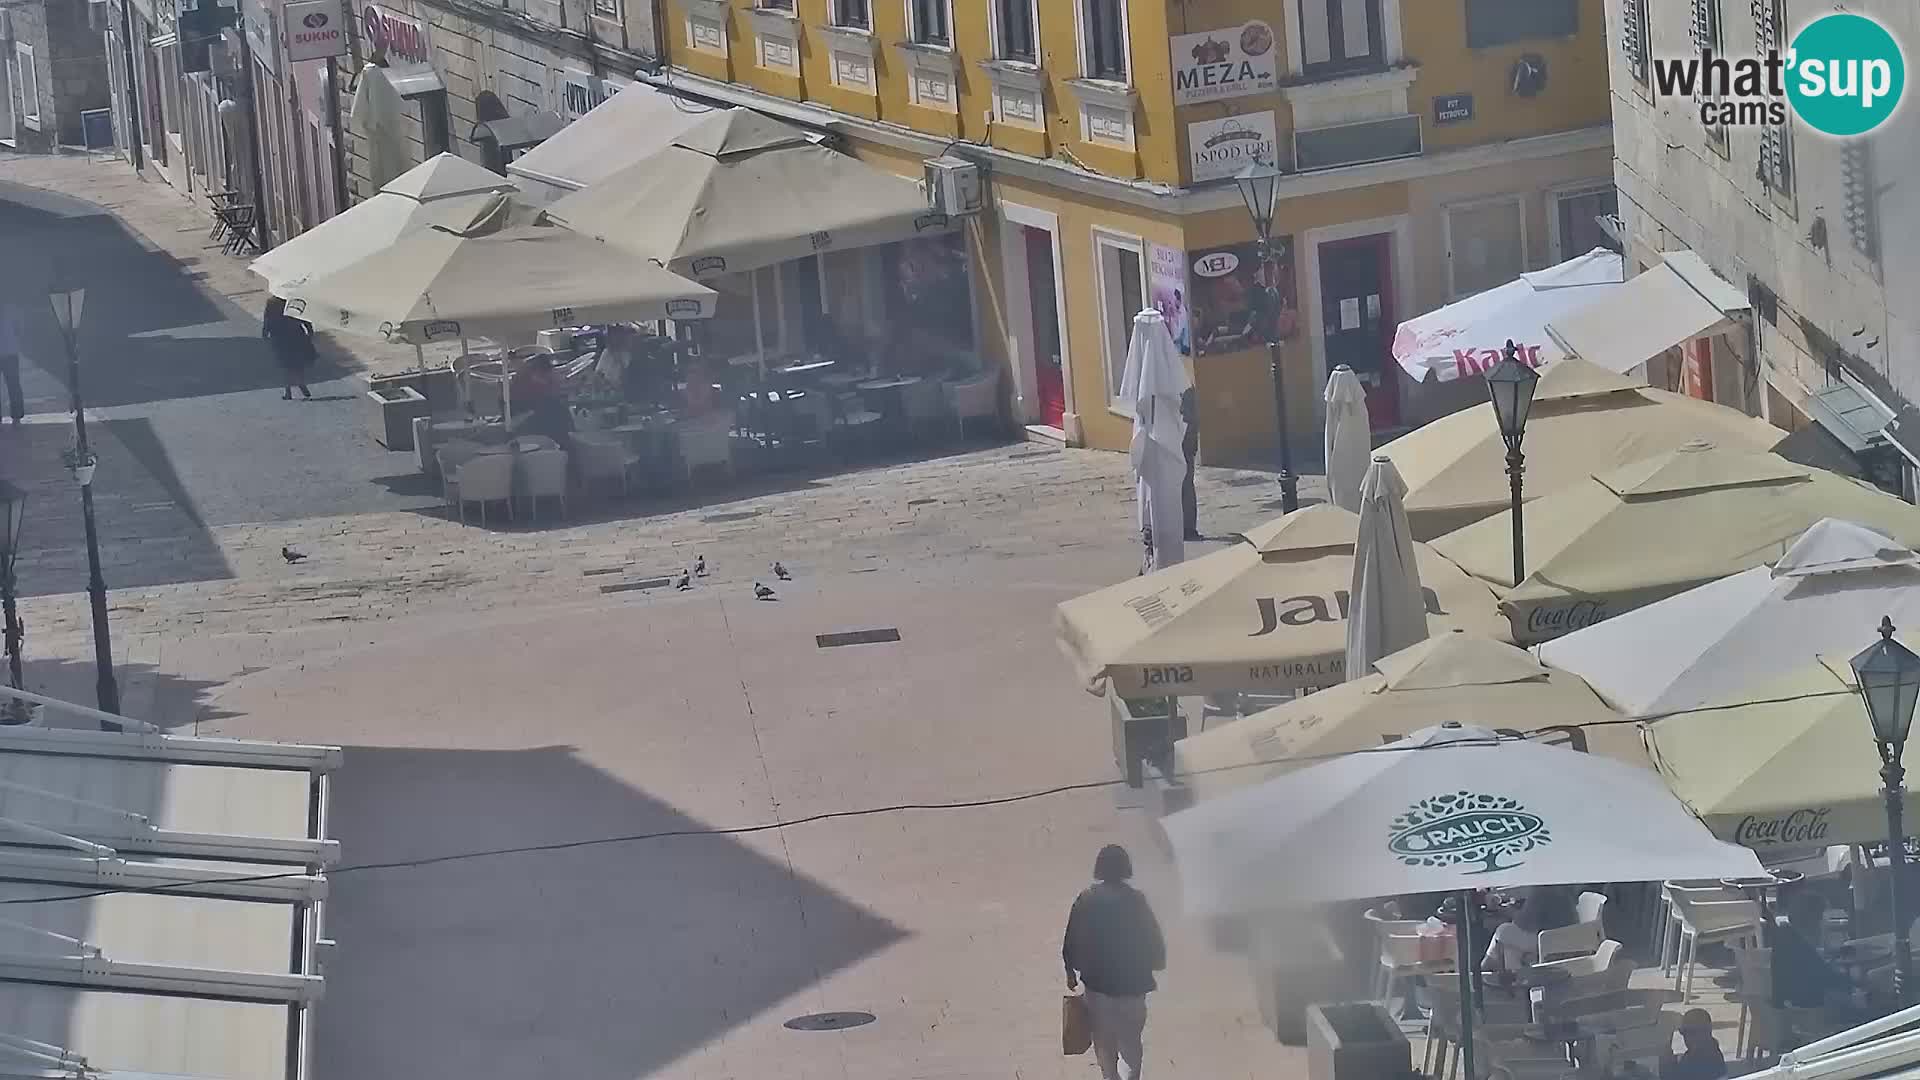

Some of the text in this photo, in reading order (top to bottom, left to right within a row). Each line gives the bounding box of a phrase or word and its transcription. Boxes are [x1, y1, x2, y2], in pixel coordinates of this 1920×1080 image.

[295, 30, 339, 44] SUKNO
[1177, 61, 1255, 90] MEZA
[1195, 145, 1241, 164] ISPOD
[1249, 662, 1326, 681] NATURAL
[1426, 816, 1526, 846] RAUCH
